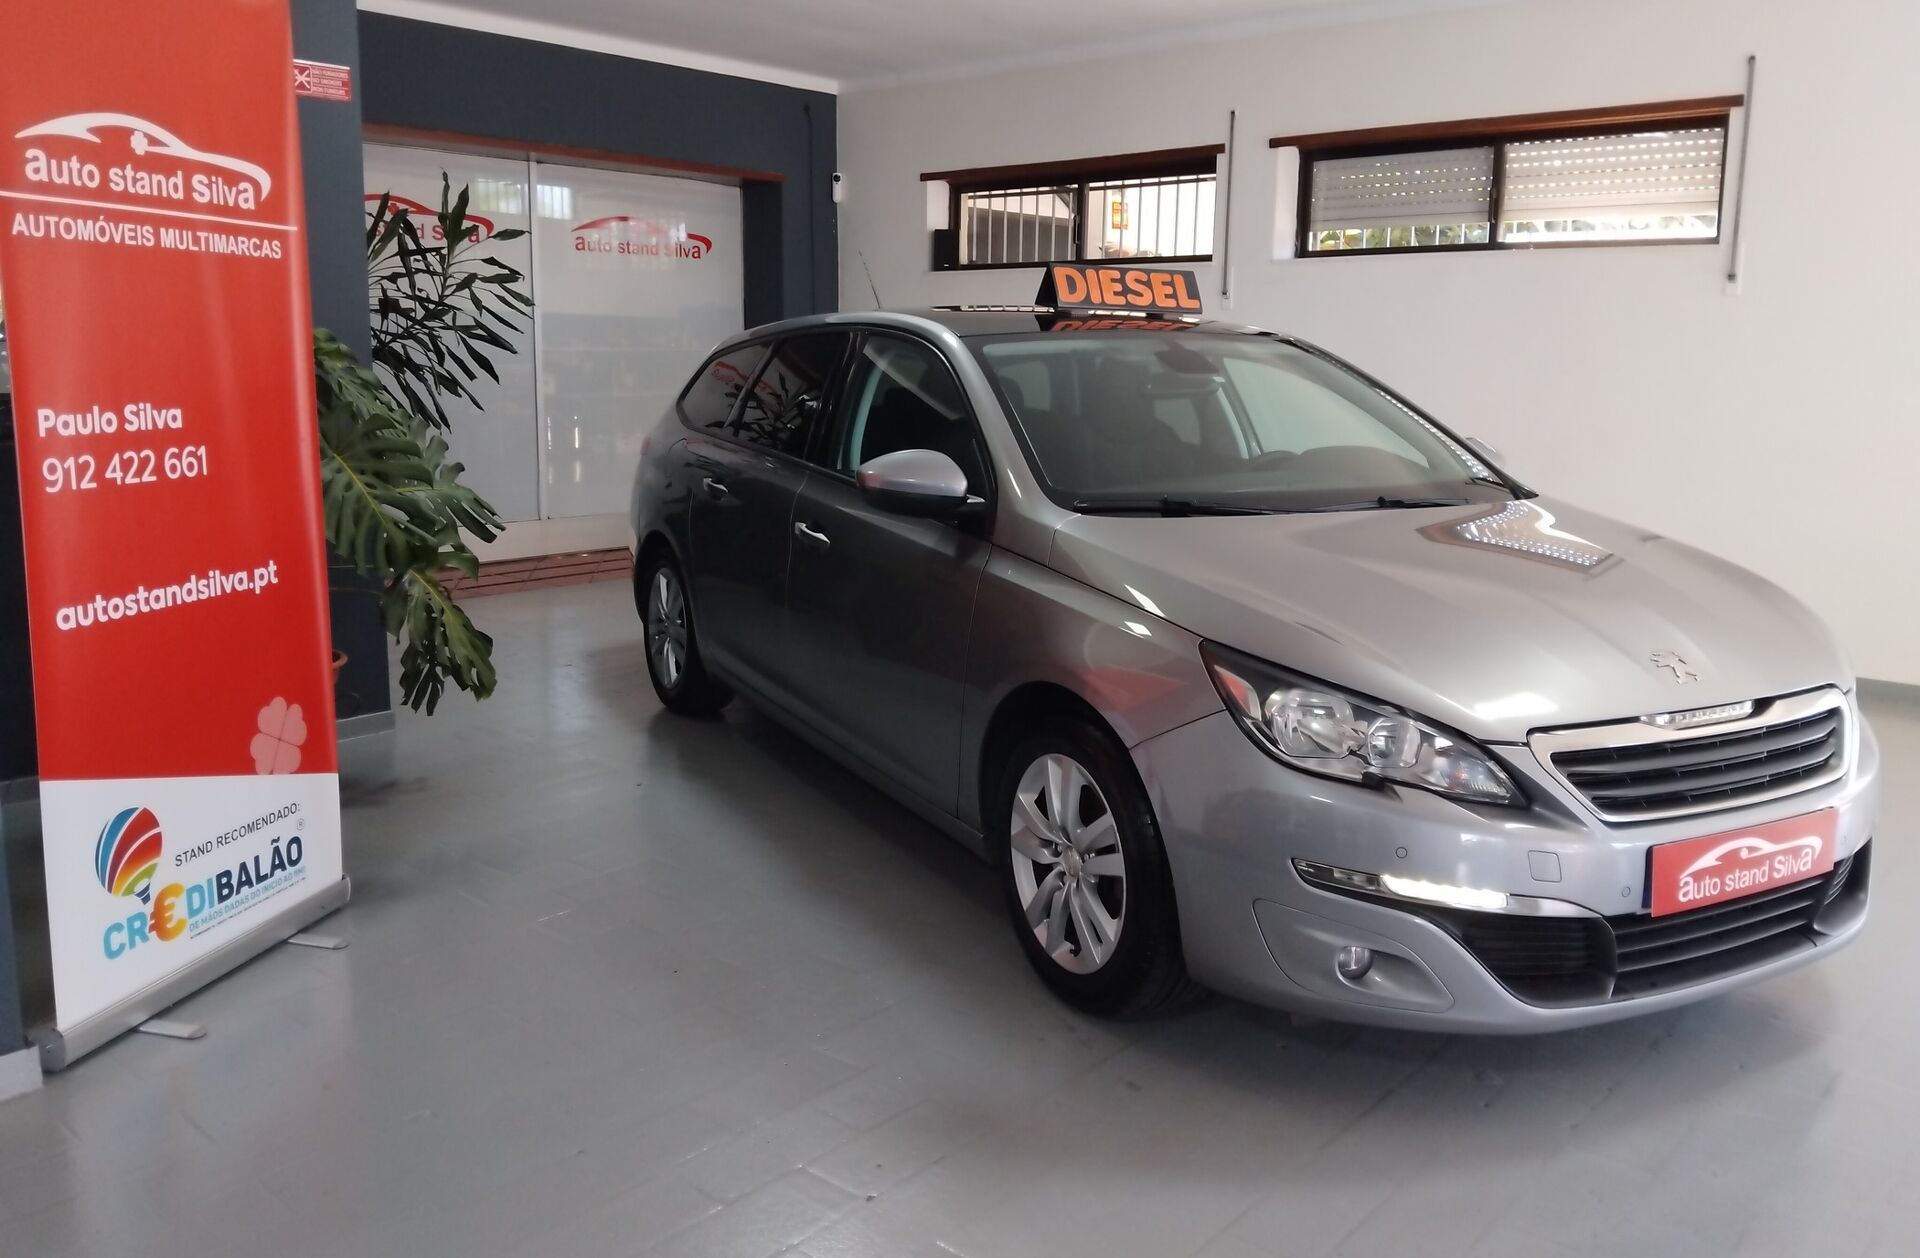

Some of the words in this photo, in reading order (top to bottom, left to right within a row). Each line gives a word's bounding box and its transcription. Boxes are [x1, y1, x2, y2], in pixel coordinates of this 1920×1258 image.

[25, 148, 100, 188] auto
[109, 164, 184, 200] stand
[192, 174, 256, 210] Silva
[12, 212, 155, 247] AUTOMÓVEIS
[160, 228, 282, 260] MULTIMARCAS
[575, 235, 612, 252] auto
[617, 240, 658, 257] stand
[1053, 266, 1201, 309] DIESEL
[37, 406, 117, 437] Paulo
[124, 403, 182, 432] Silva
[42, 455, 97, 493] 912
[105, 450, 157, 485] 422
[164, 445, 208, 479] 661
[56, 560, 278, 631] autostandsilva.pt
[175, 841, 213, 867] STAND
[216, 802, 301, 848] RECOMENDADO:
[1678, 874, 1721, 902] auto
[1725, 862, 1769, 891] stand
[1772, 846, 1812, 879] Silva
